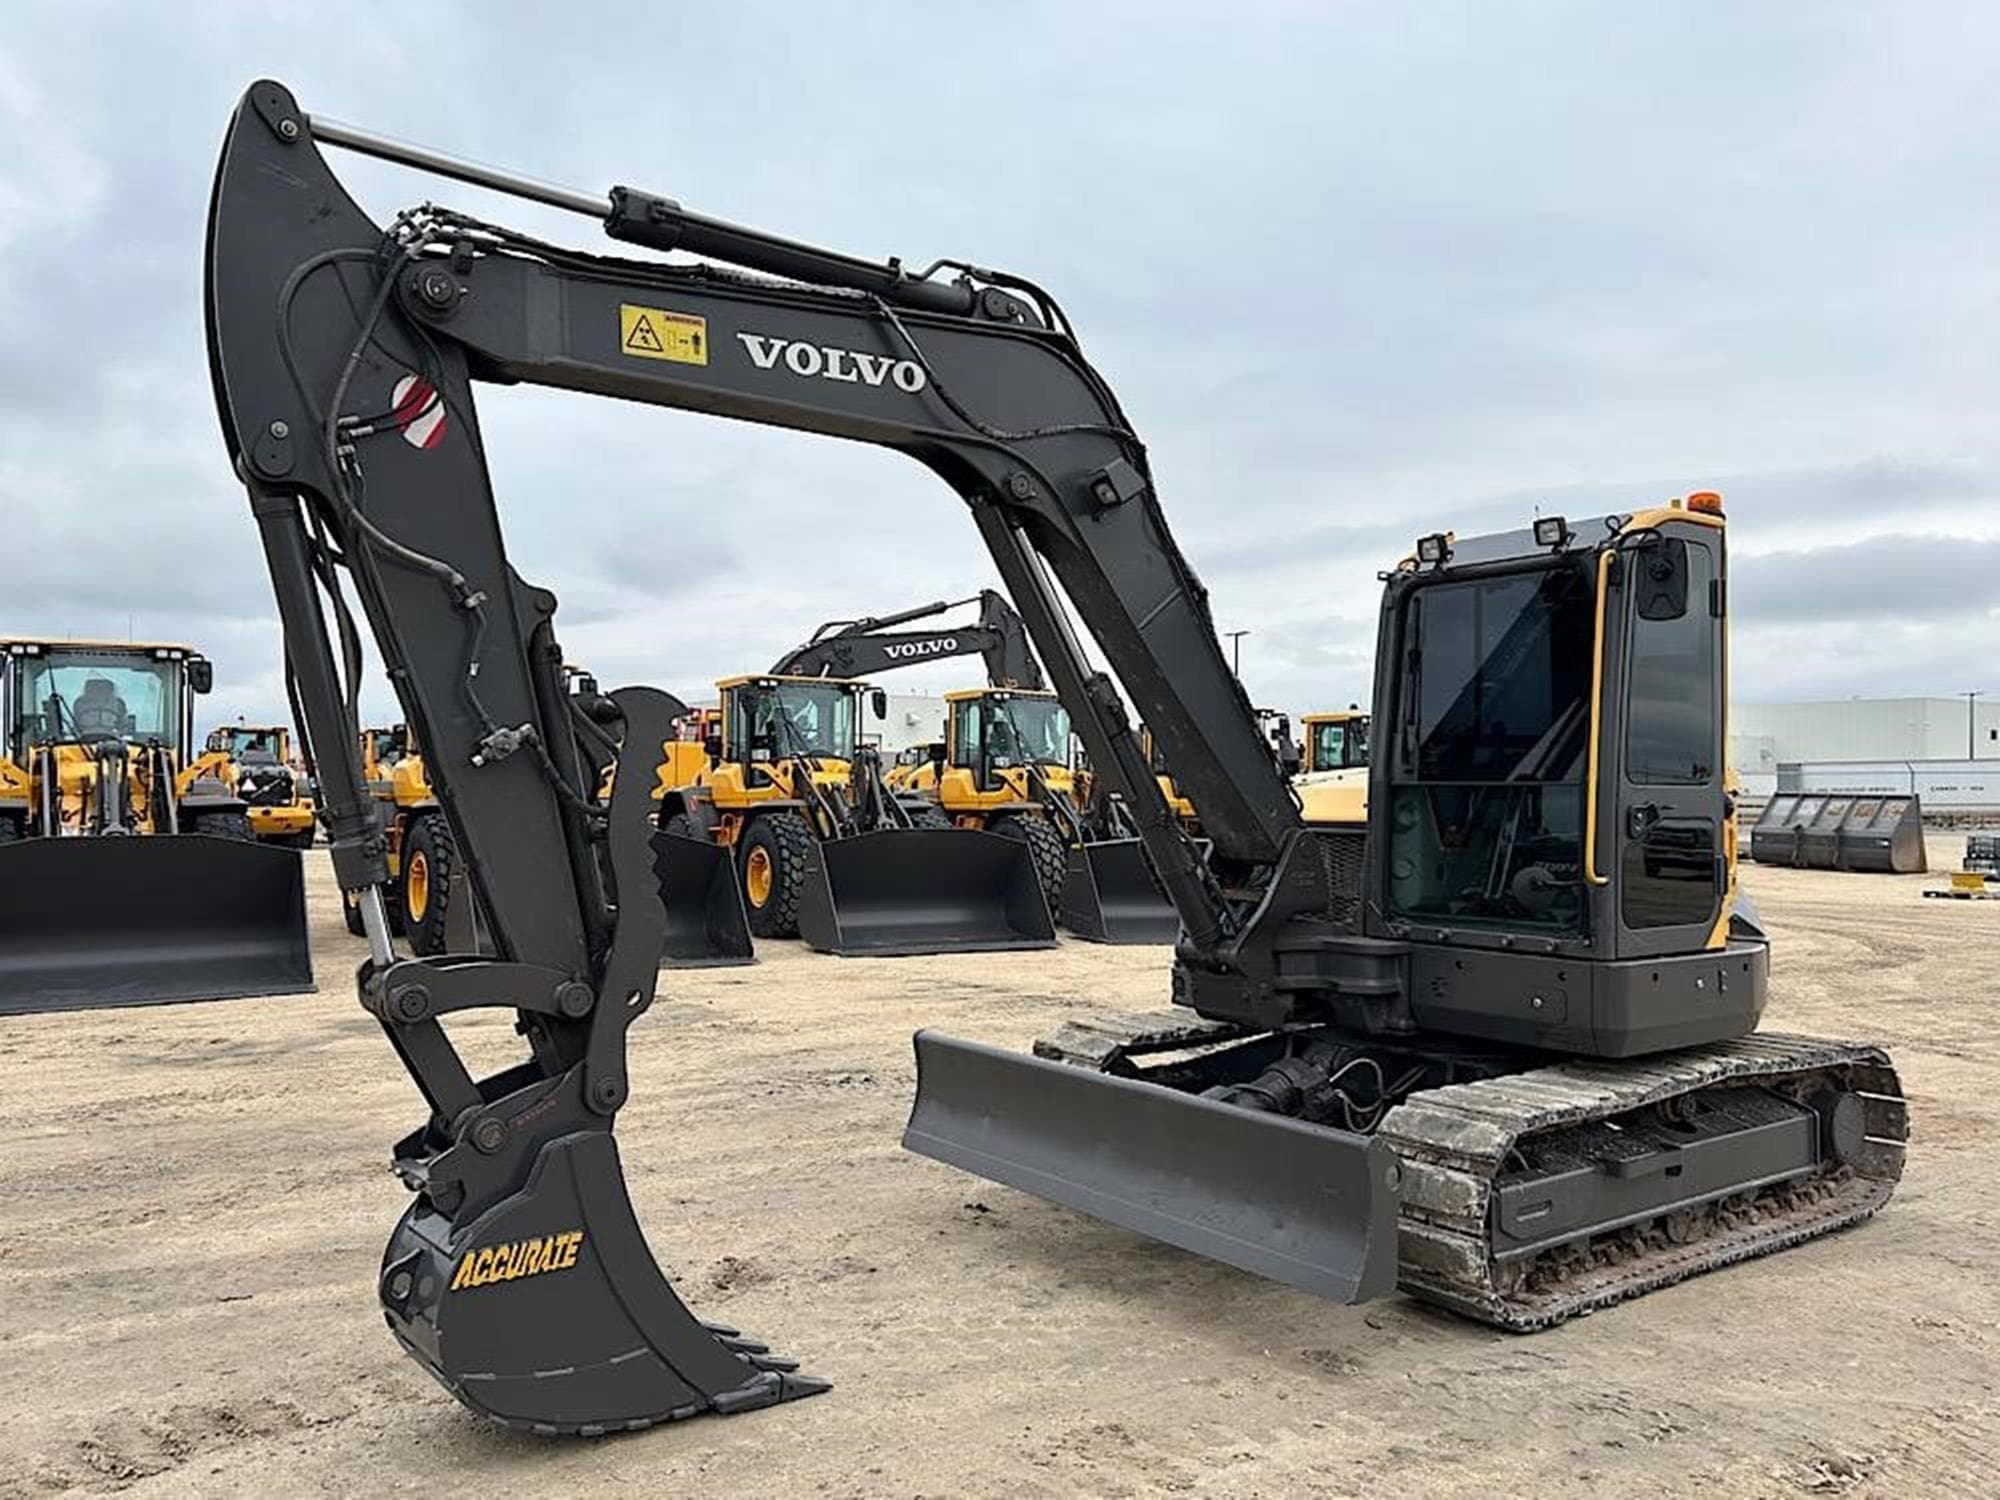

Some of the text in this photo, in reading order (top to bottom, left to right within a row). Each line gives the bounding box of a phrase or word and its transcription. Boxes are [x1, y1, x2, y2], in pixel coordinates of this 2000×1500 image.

[737, 333, 926, 393] VOLVO
[883, 637, 958, 659] VOLVO
[450, 1230, 583, 1291] ACCURATE
